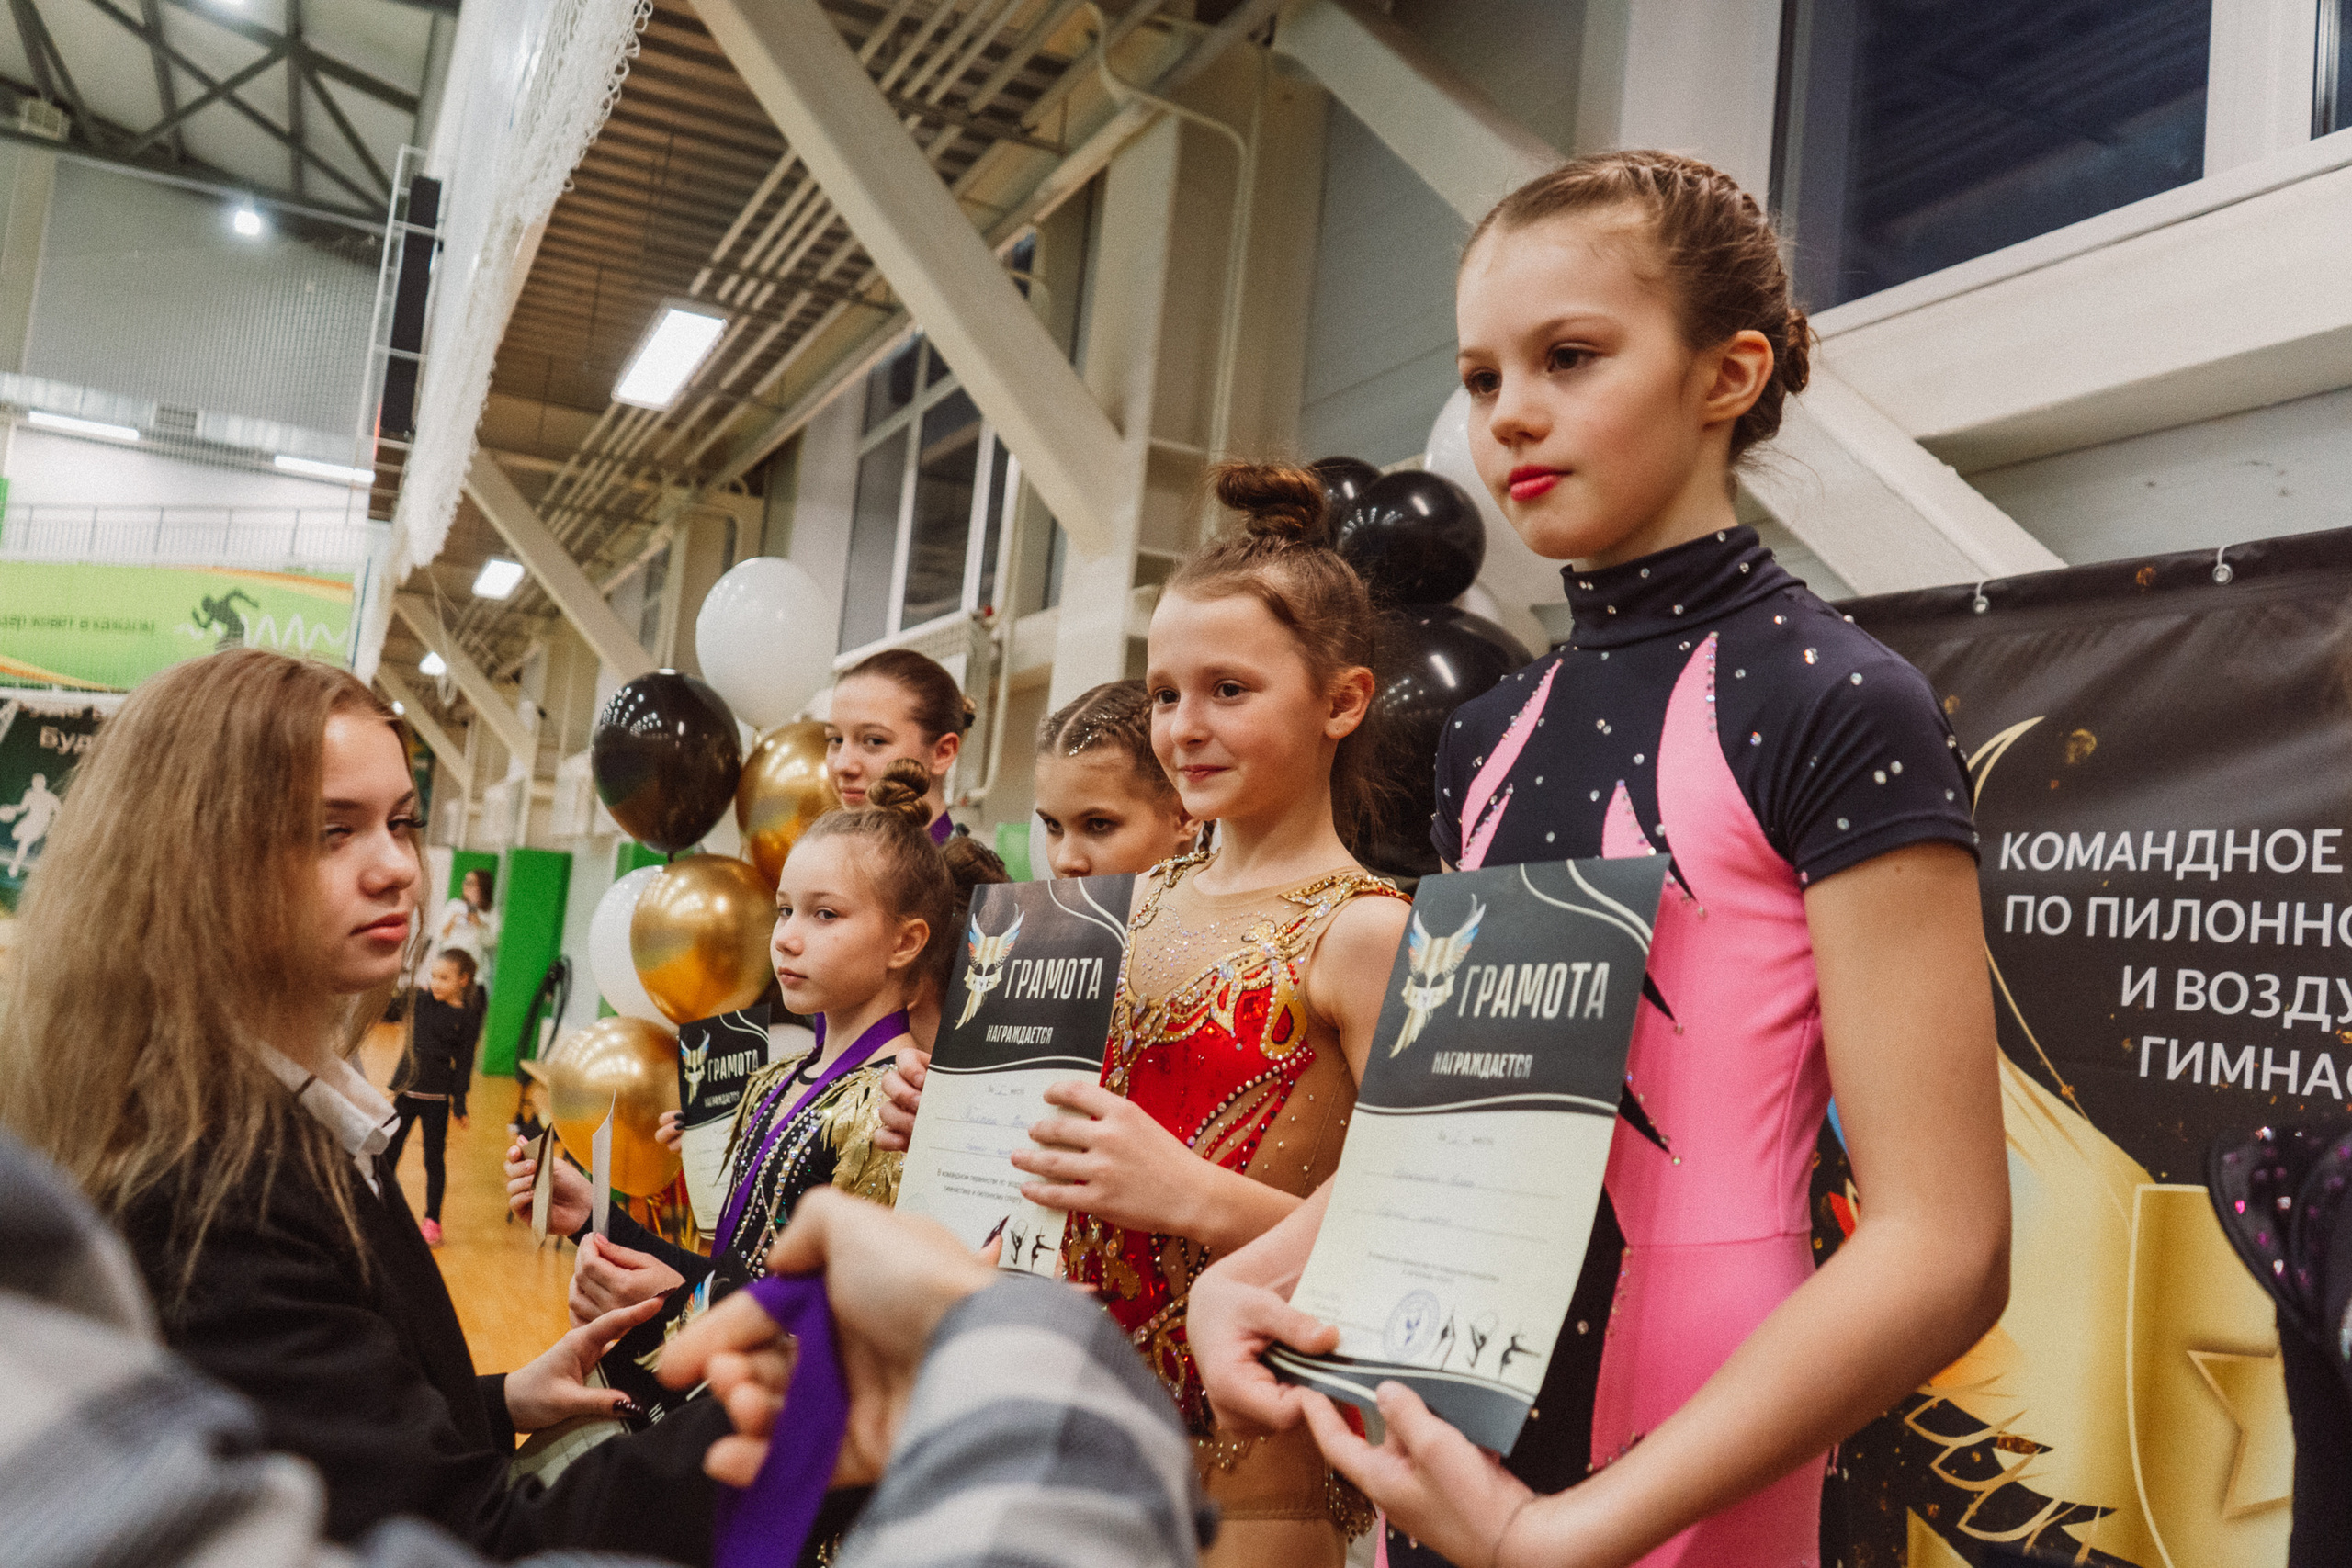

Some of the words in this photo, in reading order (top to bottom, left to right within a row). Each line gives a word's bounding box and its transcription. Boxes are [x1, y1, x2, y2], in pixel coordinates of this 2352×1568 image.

[1999, 828, 2344, 882] КОМАНДНОЕ
[2004, 894, 2073, 936] ПО
[1004, 957, 1104, 1001] ГРАМОТА
[1457, 961, 1610, 1021] ГРАМОТА
[2120, 964, 2158, 1010] И
[985, 1024, 1054, 1046] НАГРАЖДАЕТСЯ
[707, 1048, 760, 1083] ГРАМОТА
[1431, 1051, 1534, 1080] НАГРАЖДАЕТСЯ
[2139, 1035, 2352, 1100] ГИМНА
